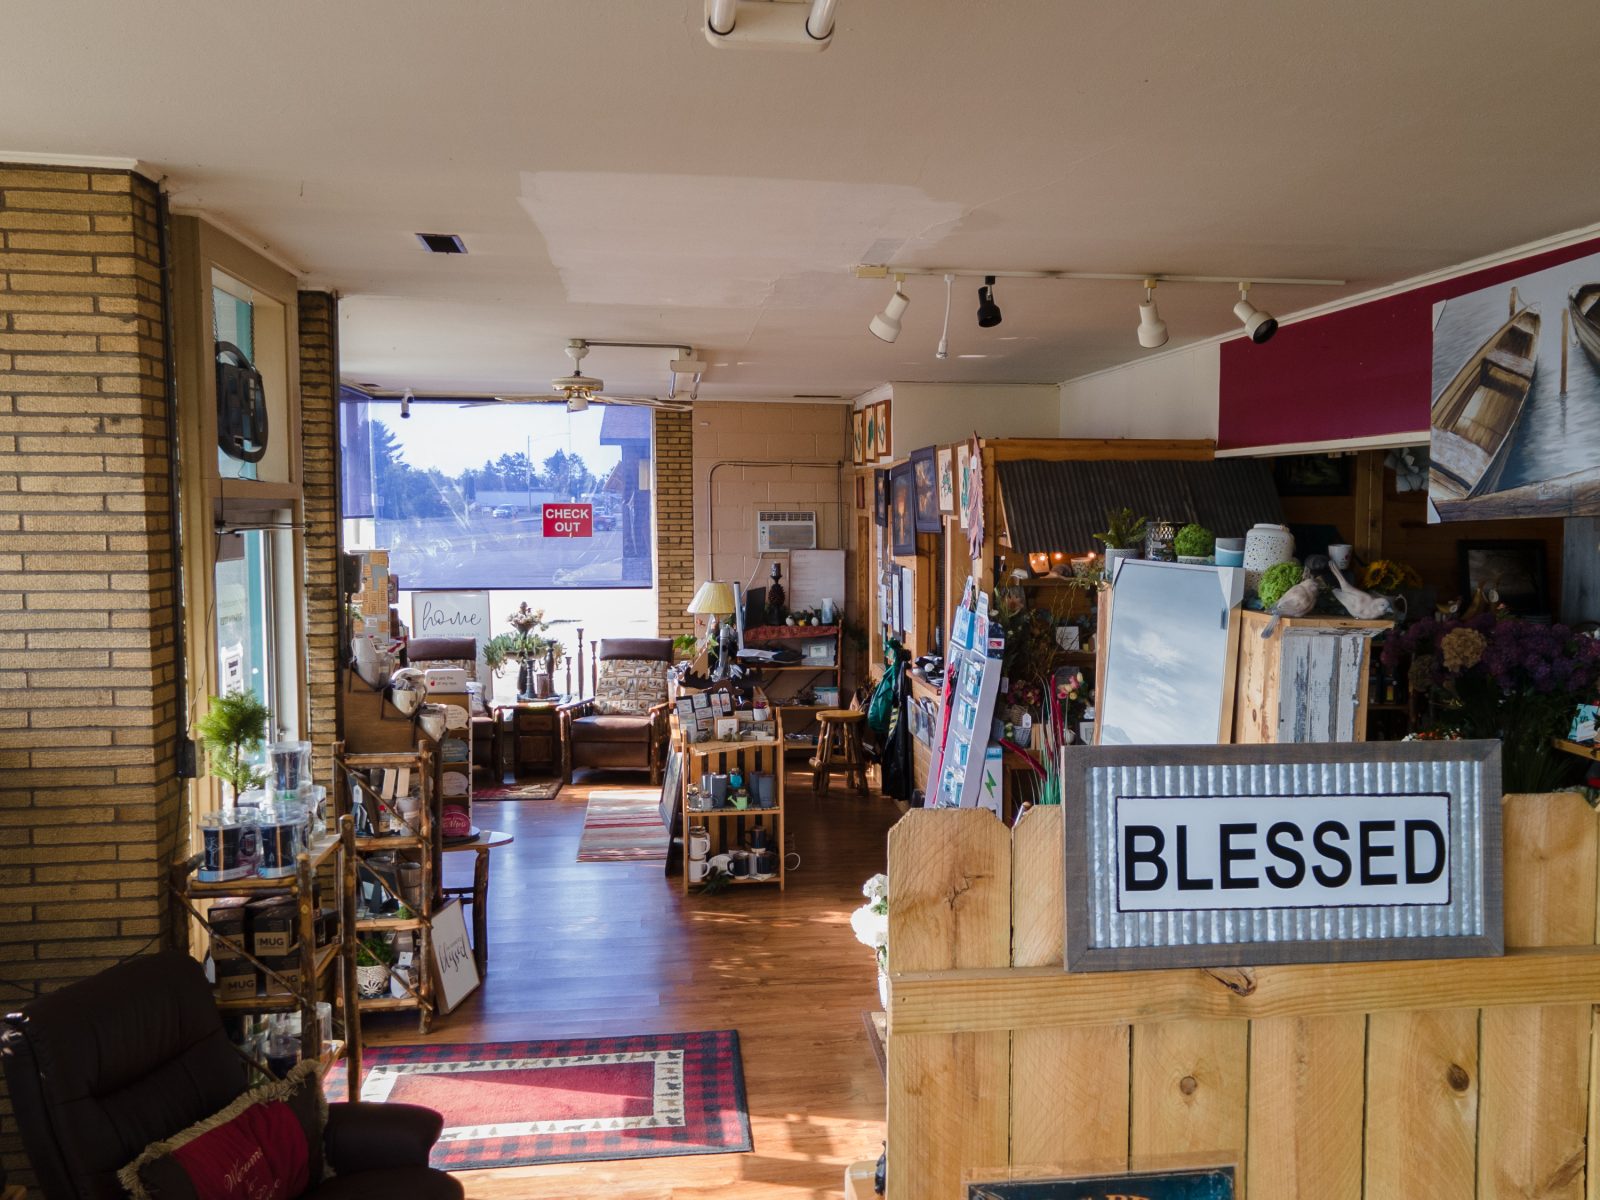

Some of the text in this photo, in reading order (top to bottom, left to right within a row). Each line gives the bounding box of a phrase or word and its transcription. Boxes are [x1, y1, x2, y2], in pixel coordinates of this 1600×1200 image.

[545, 508, 590, 519] CHECK
[554, 522, 581, 533] OUT
[422, 600, 482, 631] home
[1124, 820, 1446, 892] BLESSED
[260, 937, 284, 946] MUG
[228, 980, 254, 990] MUG
